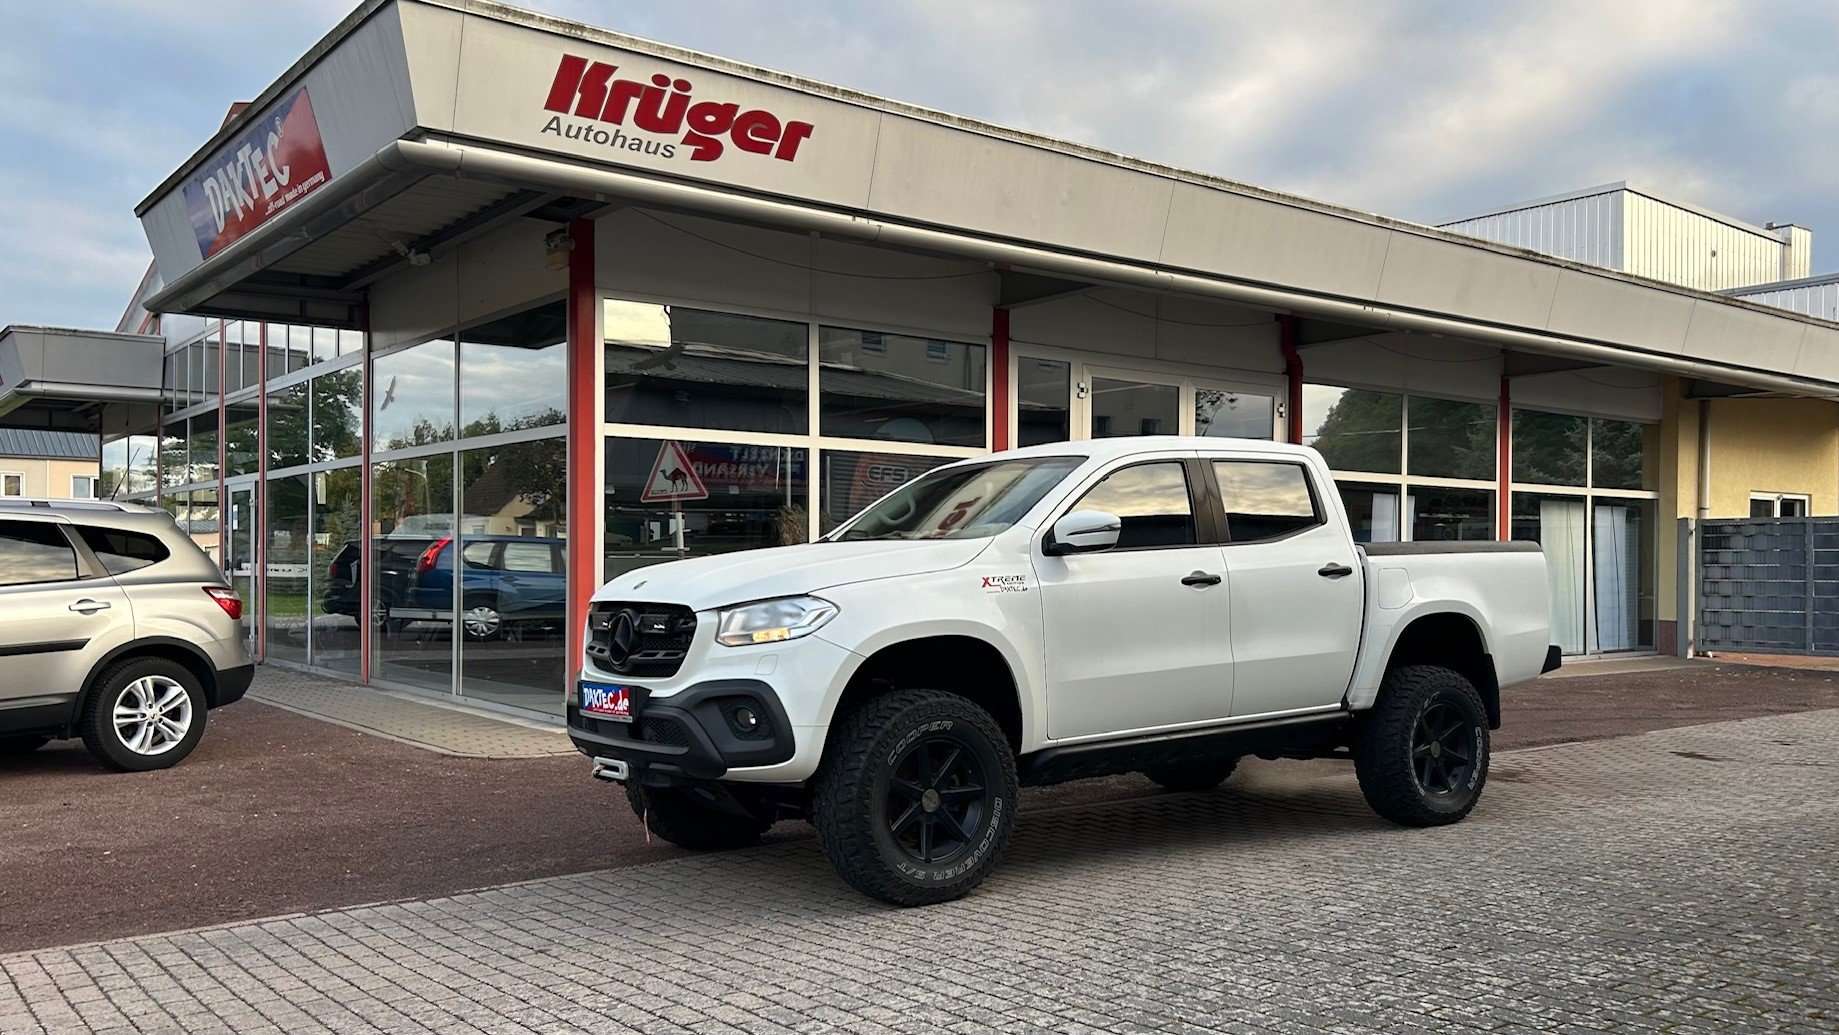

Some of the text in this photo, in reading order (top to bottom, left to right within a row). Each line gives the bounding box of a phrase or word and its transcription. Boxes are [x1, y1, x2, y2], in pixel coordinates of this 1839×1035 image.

[541, 116, 677, 159] Autohaus
[544, 53, 814, 162] Krüger
[203, 131, 290, 234] DAKTEC
[982, 575, 1026, 588] XTREME
[887, 720, 954, 766] COOPER
[934, 796, 1004, 880] DISCOVERER
